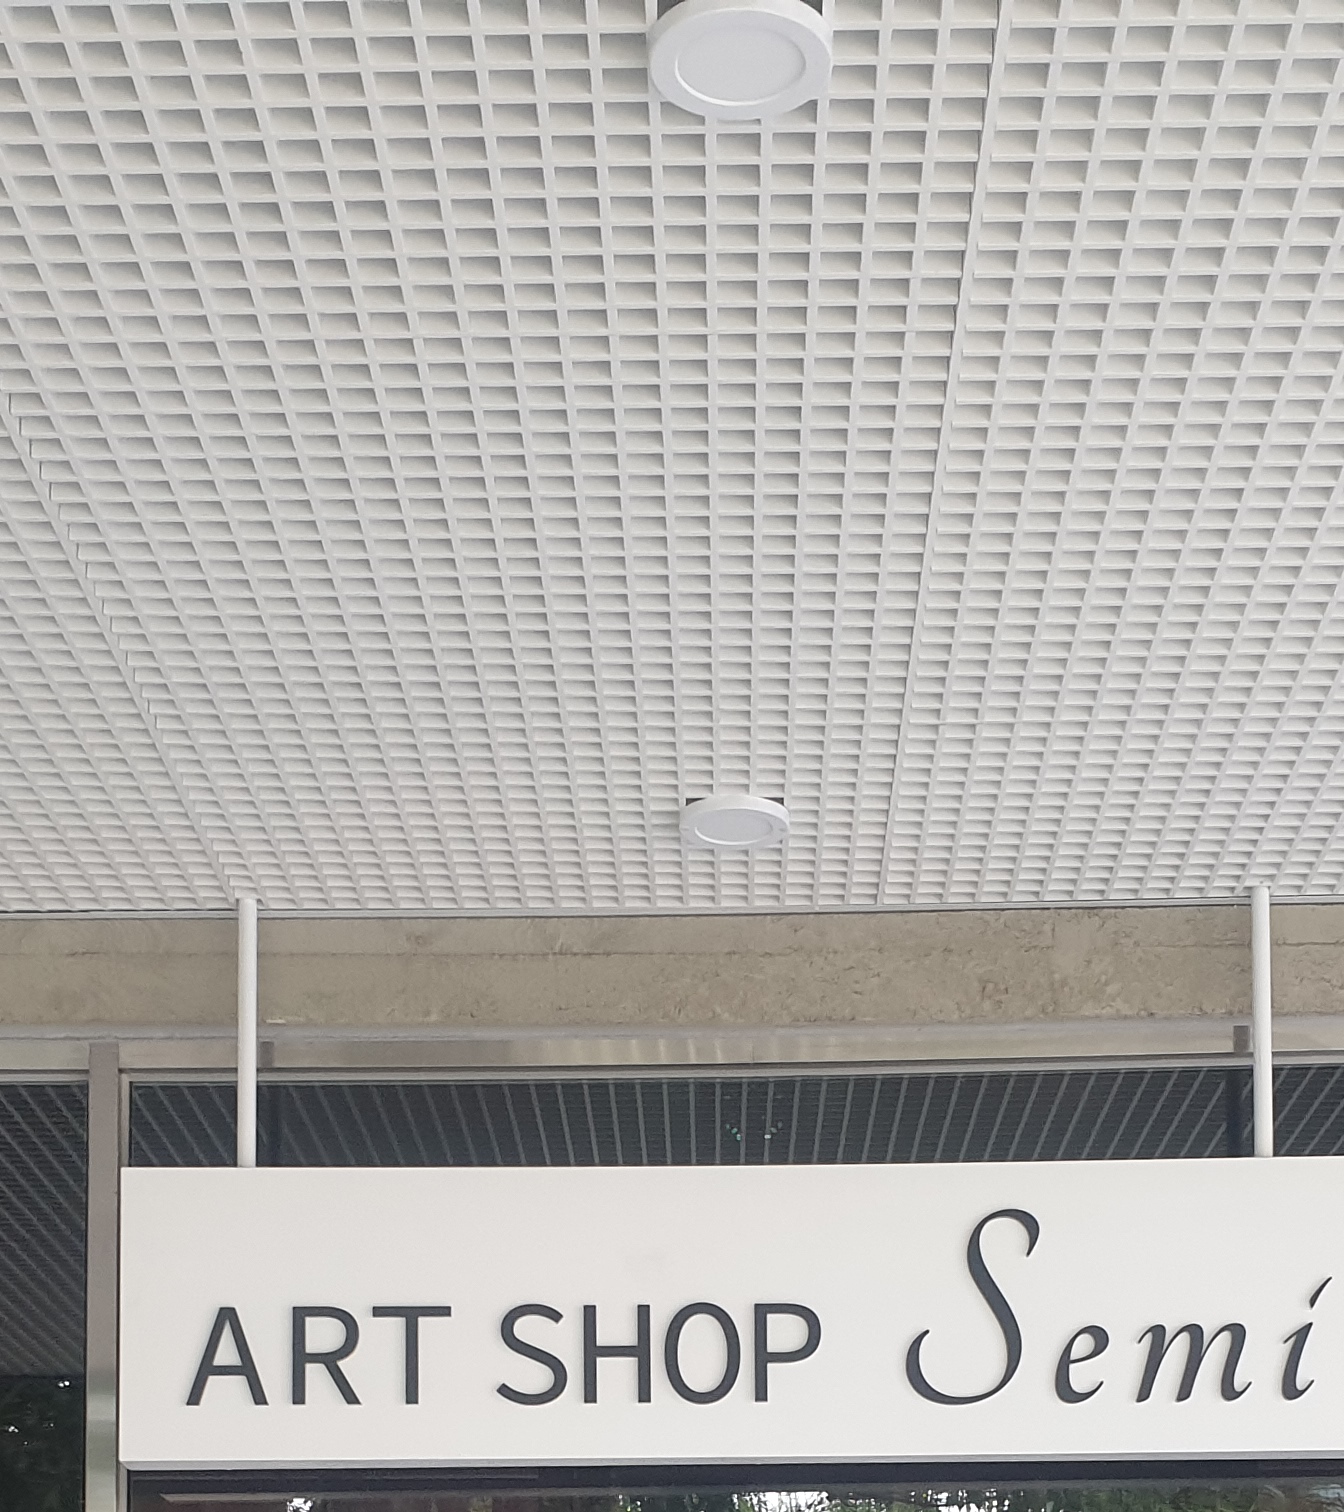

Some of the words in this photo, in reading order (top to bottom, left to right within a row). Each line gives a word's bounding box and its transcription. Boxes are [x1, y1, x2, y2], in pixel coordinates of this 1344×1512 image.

[185, 1304, 452, 1407] ART
[497, 1302, 821, 1406] SHOP
[906, 1208, 1332, 1406] Semi
